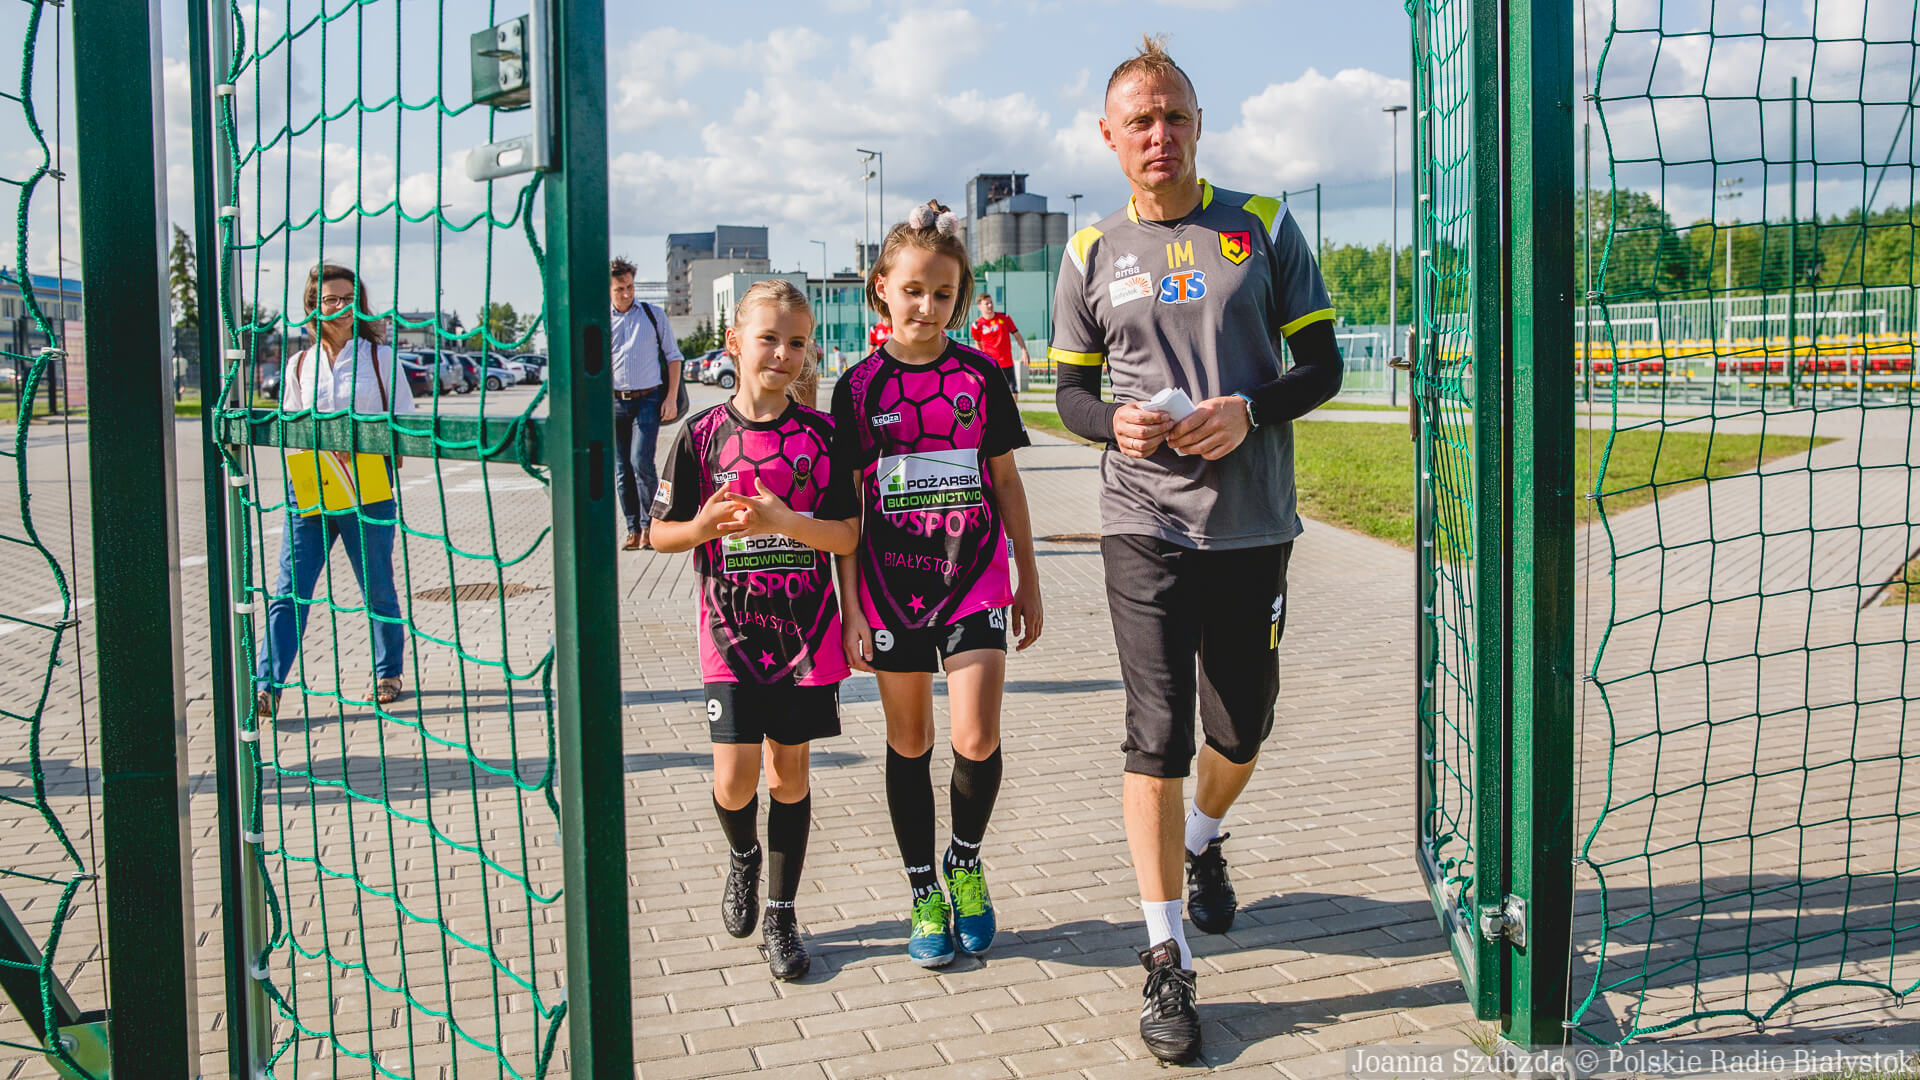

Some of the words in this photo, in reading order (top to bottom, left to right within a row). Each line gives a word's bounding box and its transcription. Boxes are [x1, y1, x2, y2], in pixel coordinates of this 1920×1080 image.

[1166, 240, 1195, 269] IM
[1160, 270, 1207, 304] STS
[884, 552, 962, 577] BIAŁYSTOK
